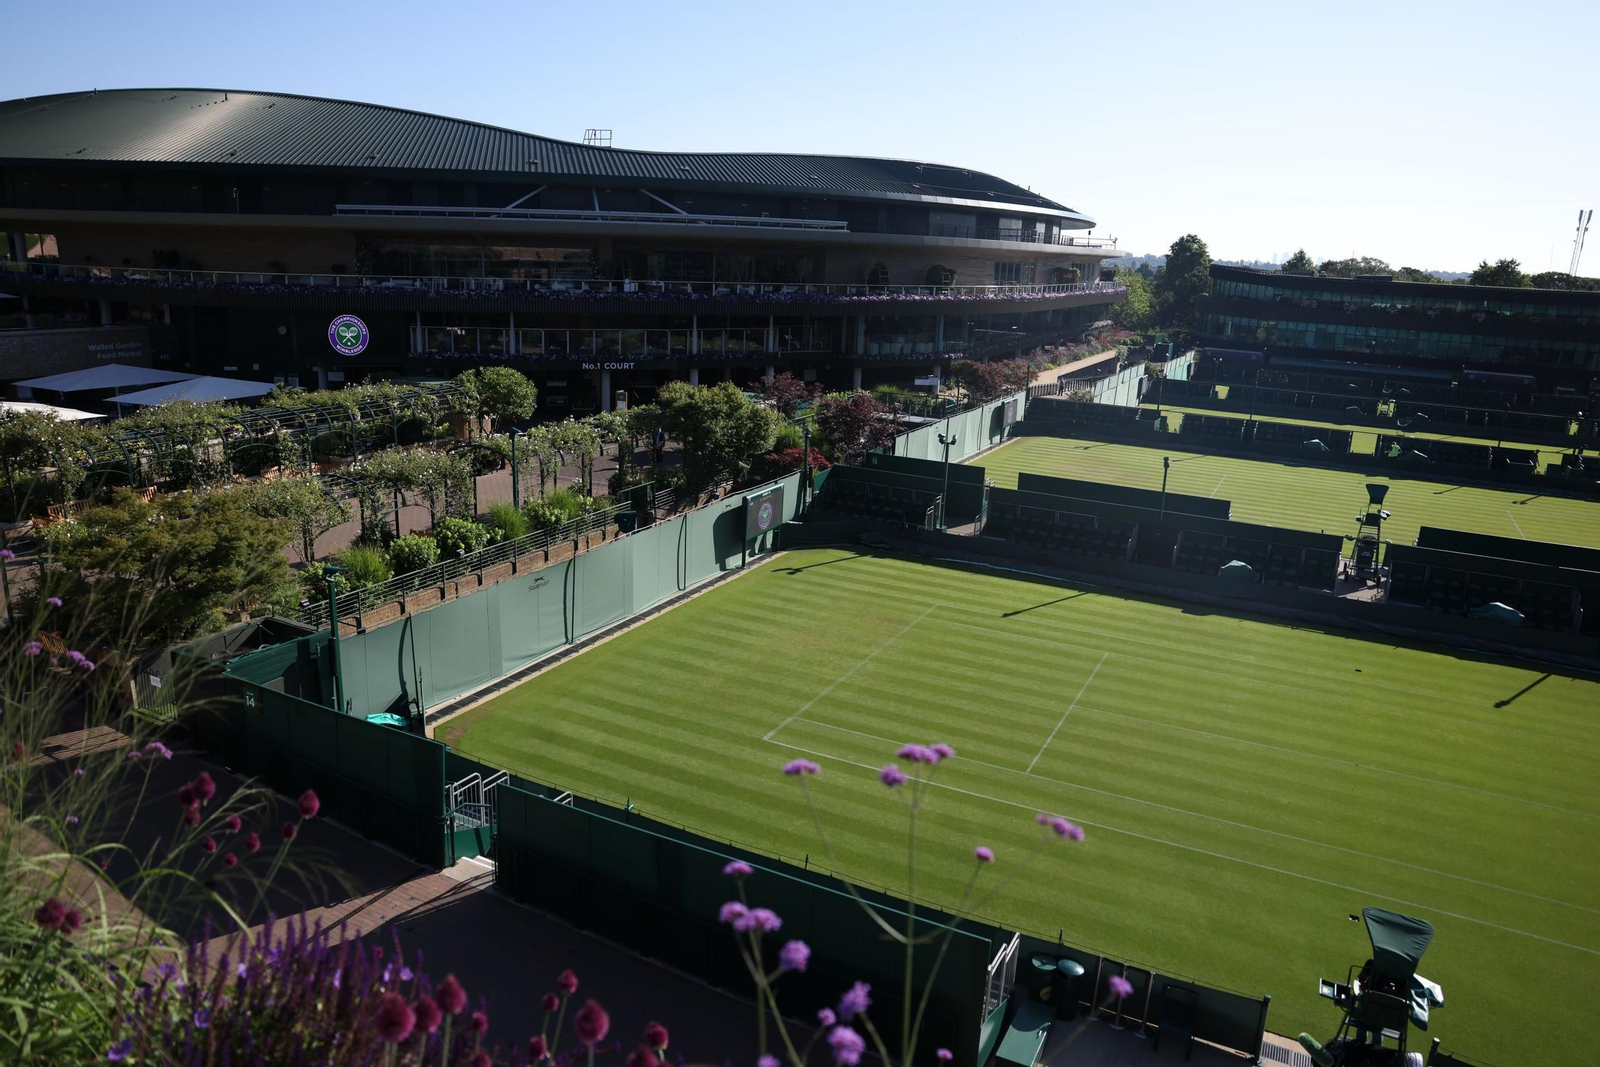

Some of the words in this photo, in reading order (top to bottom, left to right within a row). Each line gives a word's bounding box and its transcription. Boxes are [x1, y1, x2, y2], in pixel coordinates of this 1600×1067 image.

[87, 343, 114, 351] Walled
[336, 344, 363, 353] WIMBLEDON
[97, 352, 117, 360] Food
[118, 350, 143, 358] Market
[245, 695, 255, 708] 14
